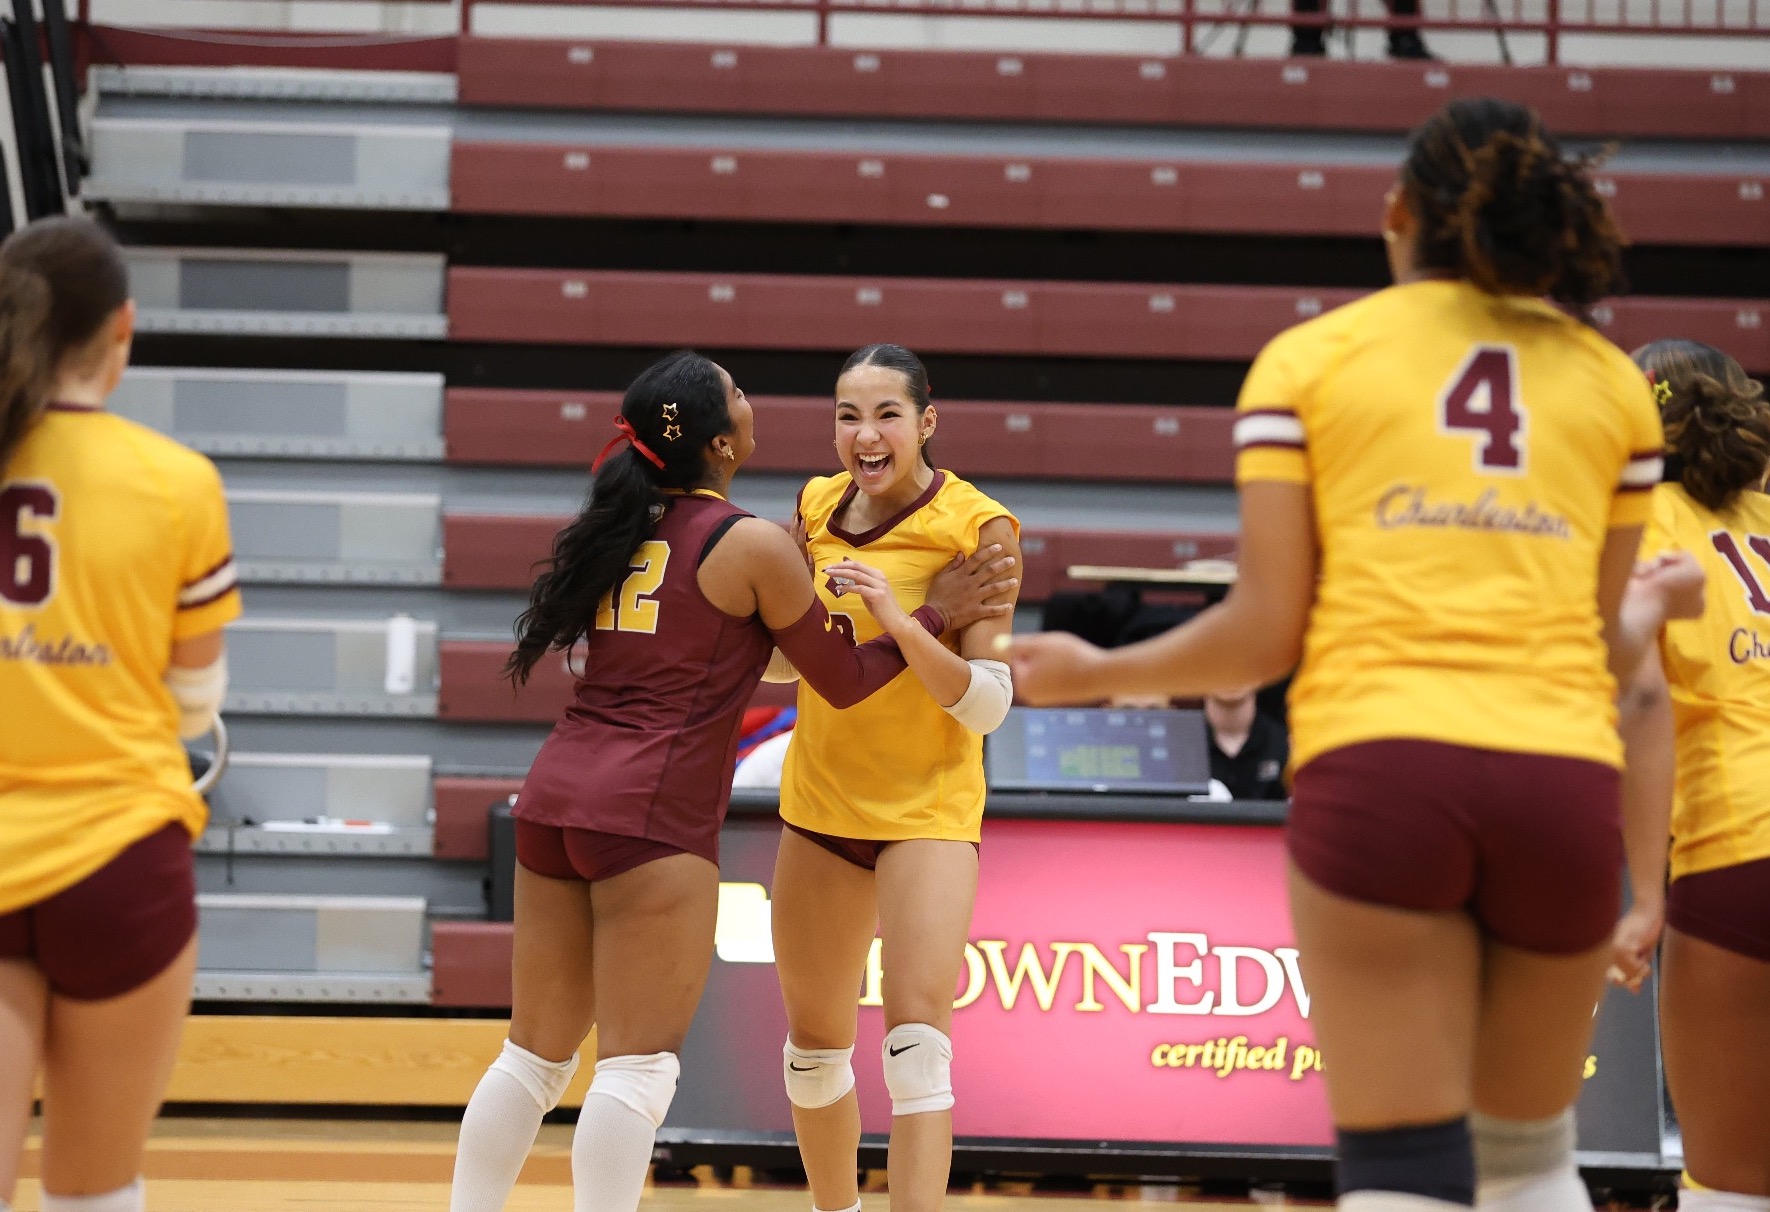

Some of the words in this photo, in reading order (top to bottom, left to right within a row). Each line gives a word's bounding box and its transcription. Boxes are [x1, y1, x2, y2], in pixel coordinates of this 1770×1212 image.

[1437, 342, 1526, 475] 4
[0, 480, 61, 611] 6
[1376, 484, 1570, 540] Charleston
[1150, 1035, 1288, 1078] certified
